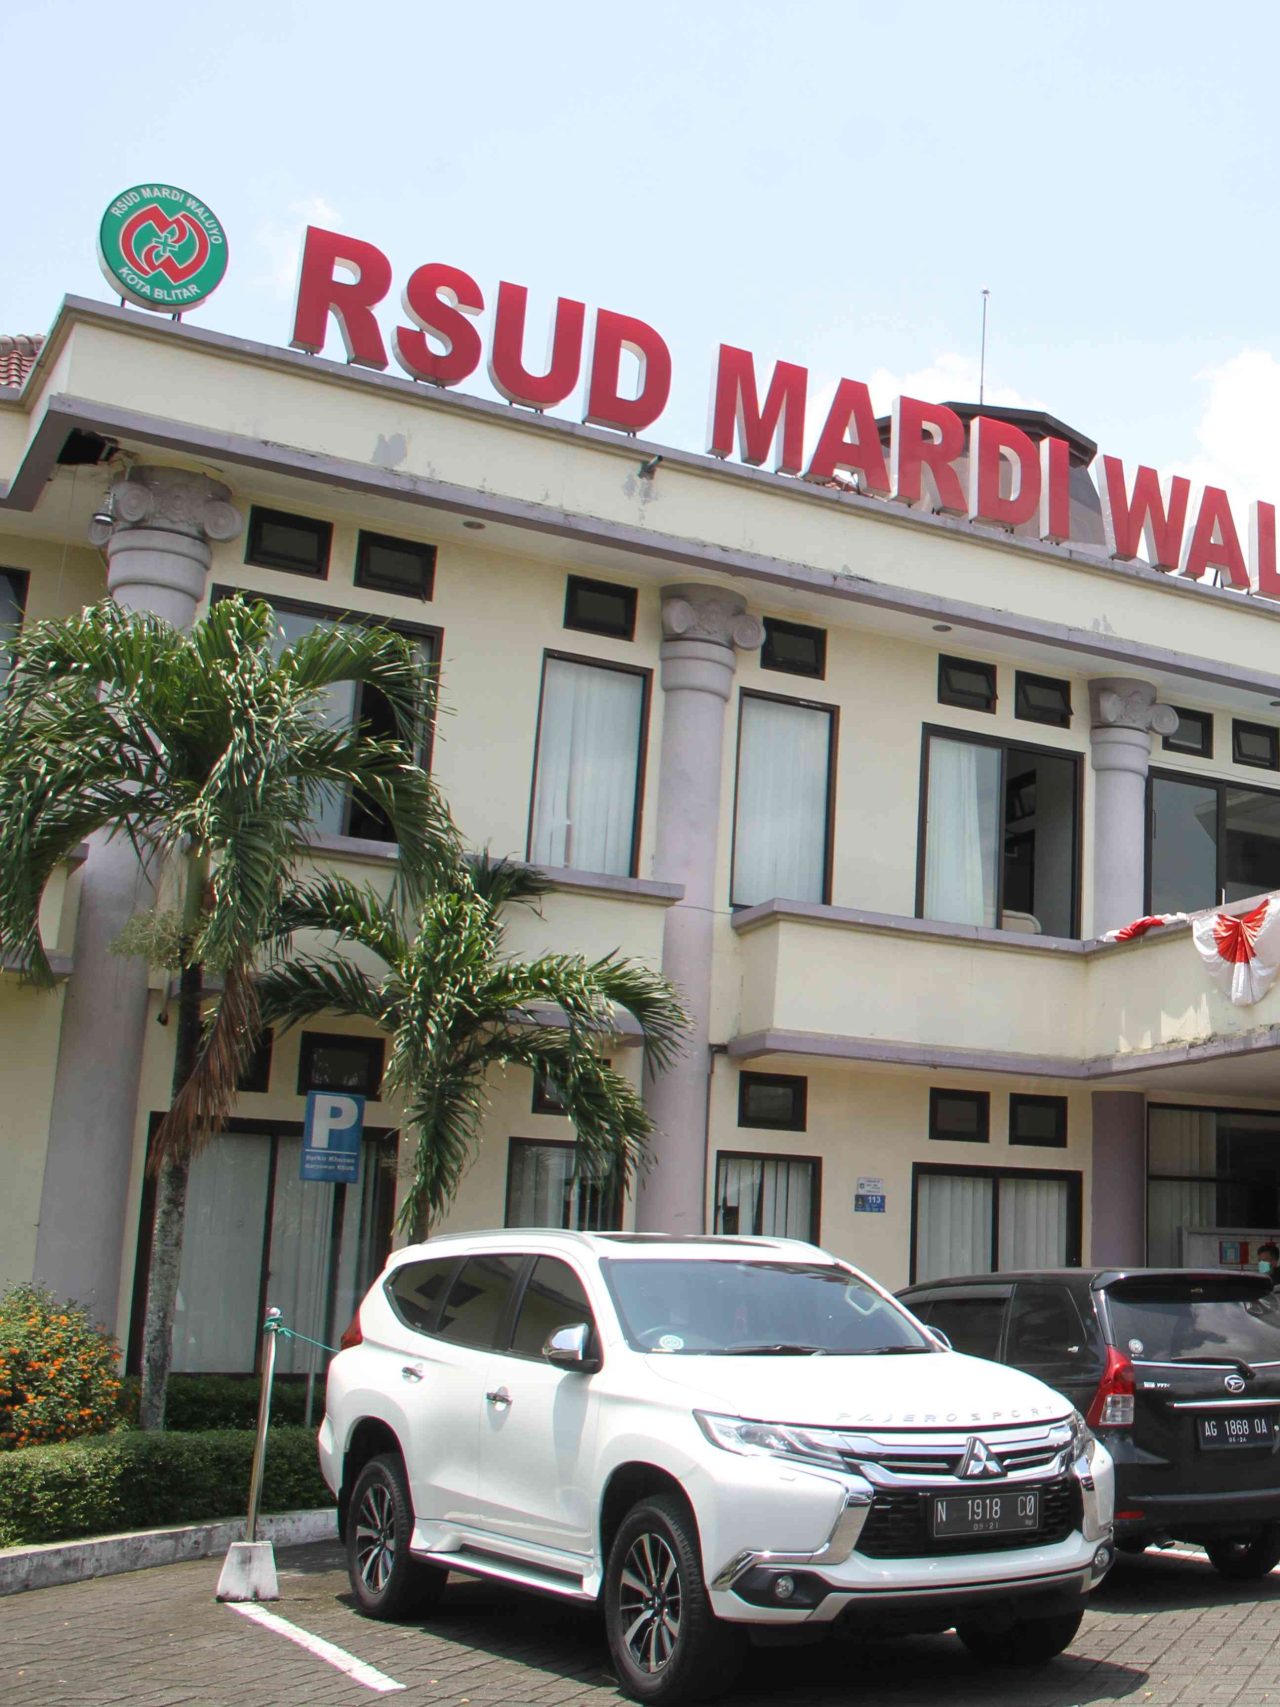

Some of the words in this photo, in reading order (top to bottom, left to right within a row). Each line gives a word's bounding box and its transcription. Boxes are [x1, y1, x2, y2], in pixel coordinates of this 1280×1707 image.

[110, 191, 141, 218] RSUD
[140, 187, 185, 203] MARDI
[185, 197, 223, 245] WALUYO
[118, 266, 151, 296] KOTA
[153, 284, 201, 301] BLITAR
[290, 225, 672, 433] RSUD
[706, 343, 1070, 546] MARDI
[311, 1094, 359, 1149] P
[835, 1411, 958, 1424] PAJERO
[970, 1405, 1054, 1422] SPORT
[1204, 1420, 1218, 1437] AG
[1224, 1419, 1250, 1436] 1868
[937, 1500, 946, 1523] N
[967, 1497, 1001, 1521] 1918
